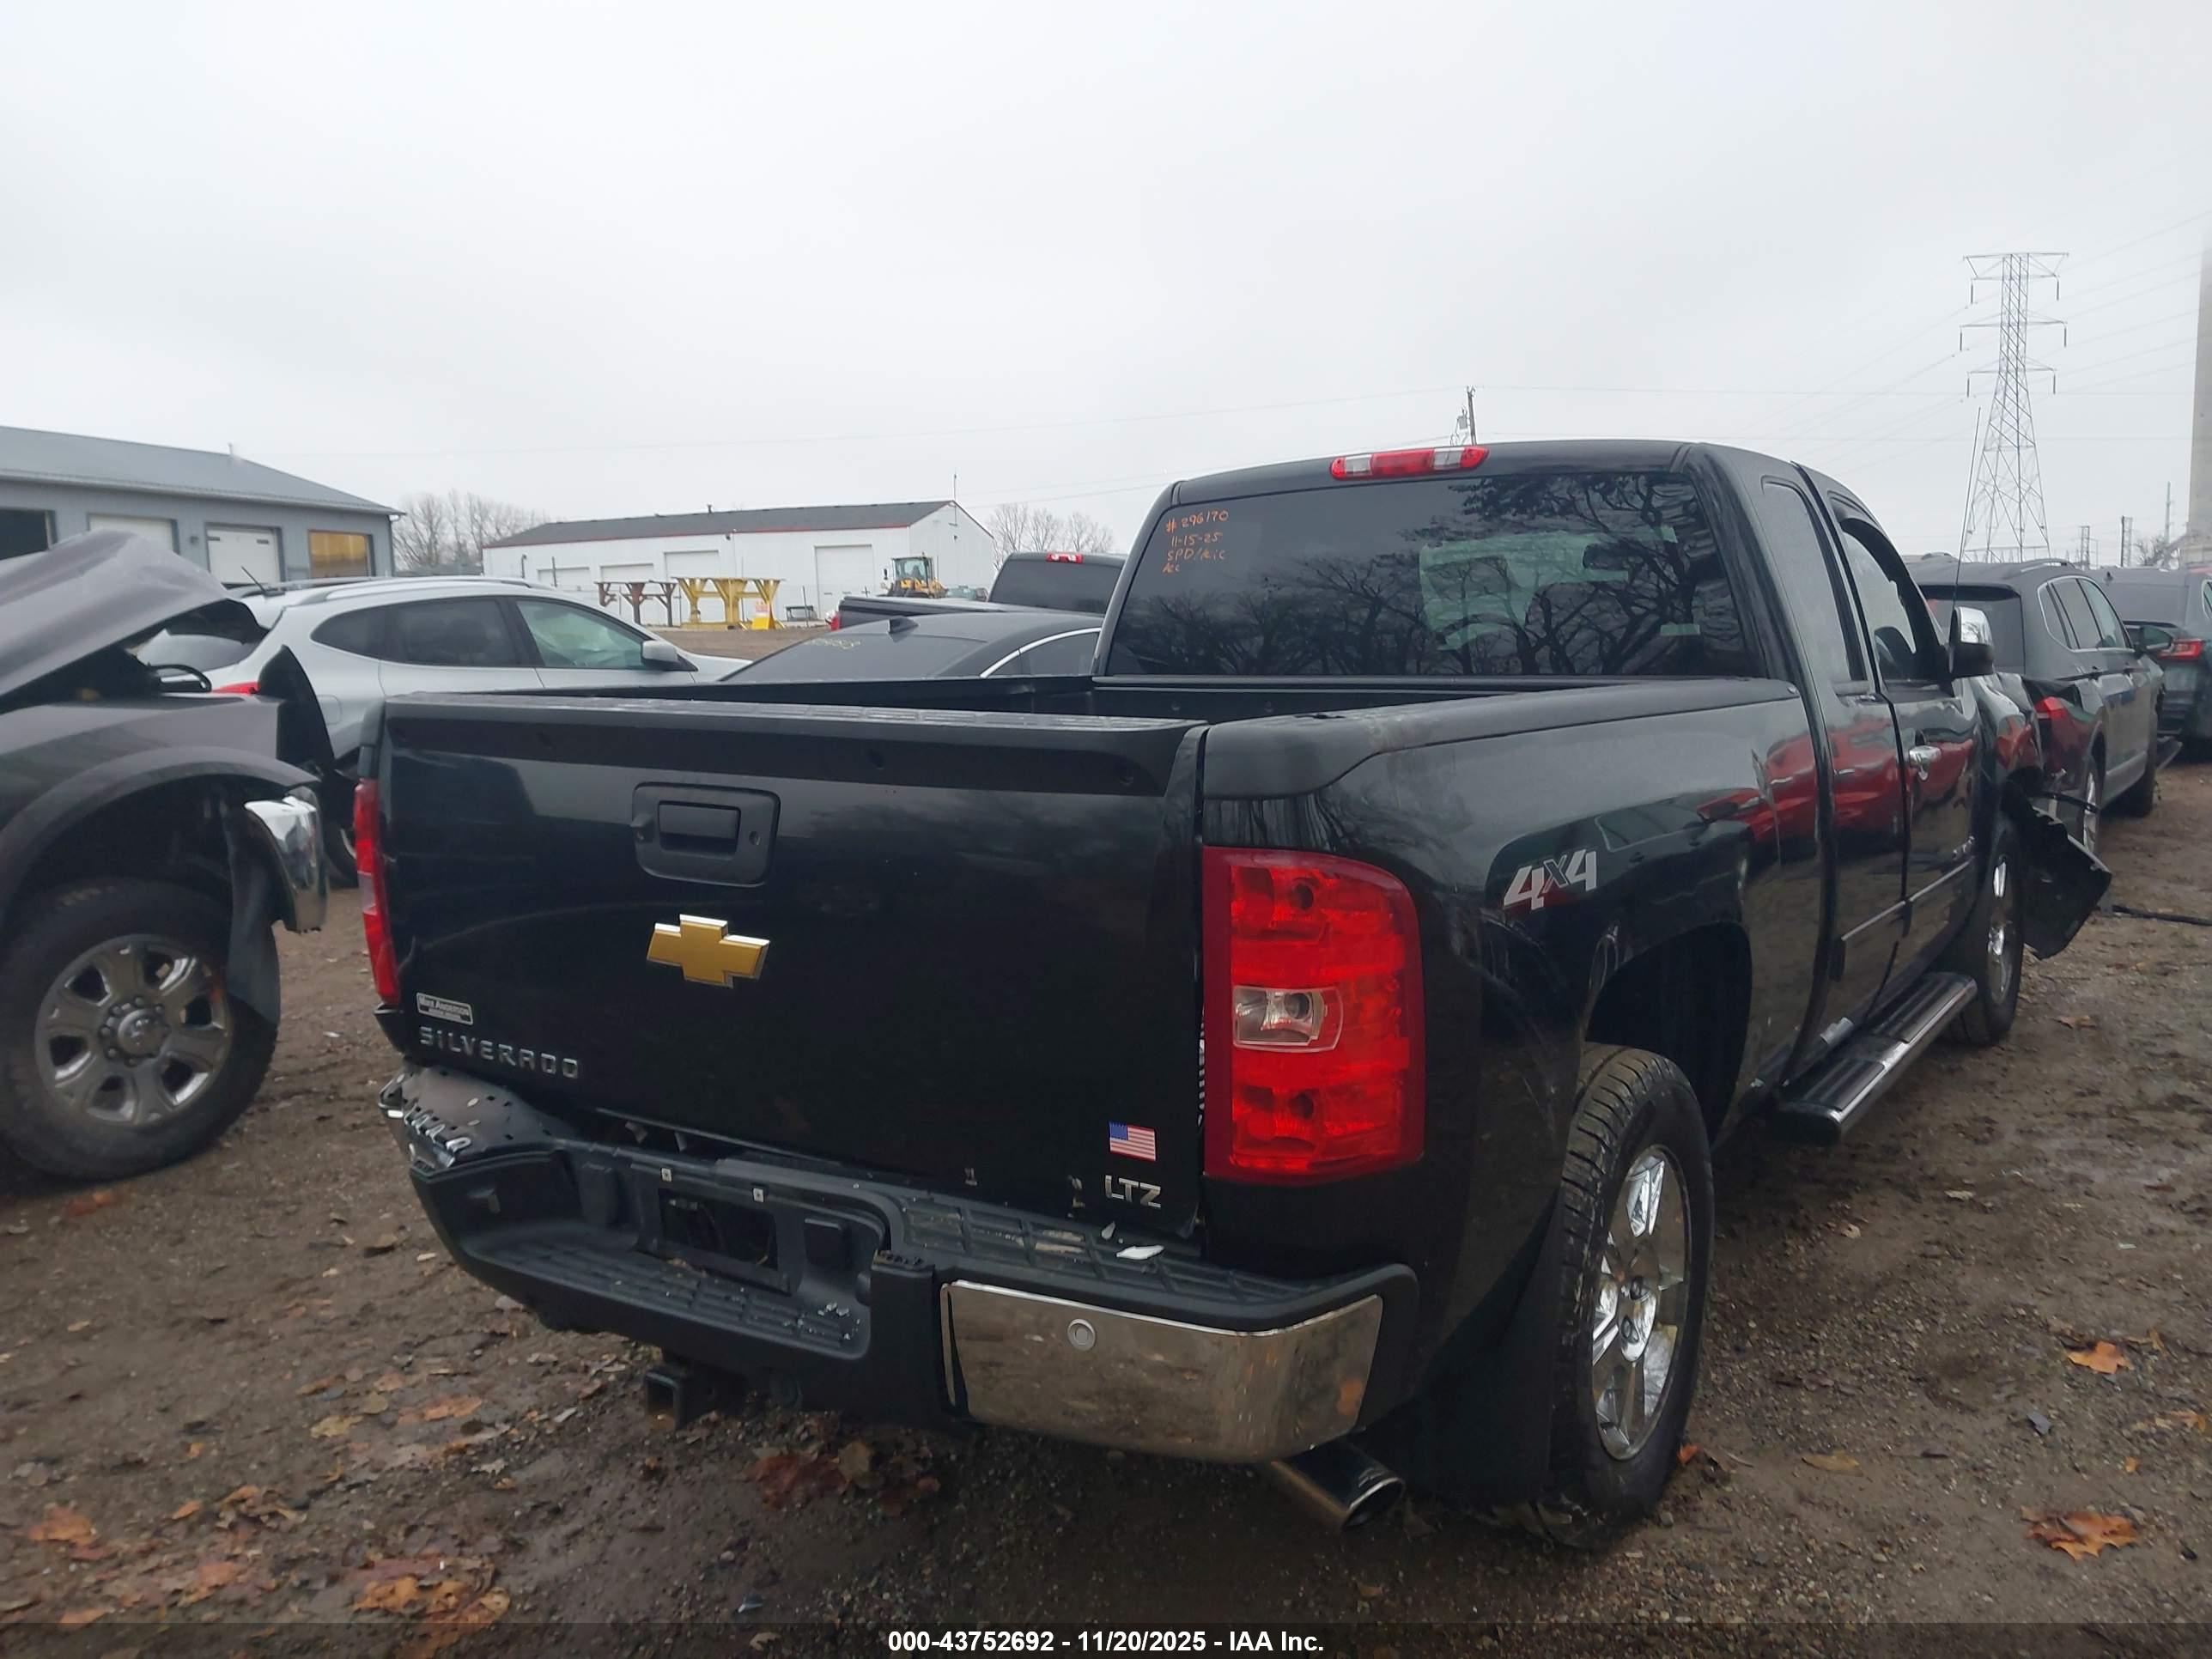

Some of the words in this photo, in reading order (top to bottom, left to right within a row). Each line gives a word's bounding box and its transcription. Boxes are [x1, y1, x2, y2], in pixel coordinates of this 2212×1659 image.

[1181, 510, 1229, 528] 296170
[1171, 532, 1223, 547] 11-15-25
[420, 1026, 578, 1079] SILVERADO
[1105, 1175, 1161, 1208] LTZ
